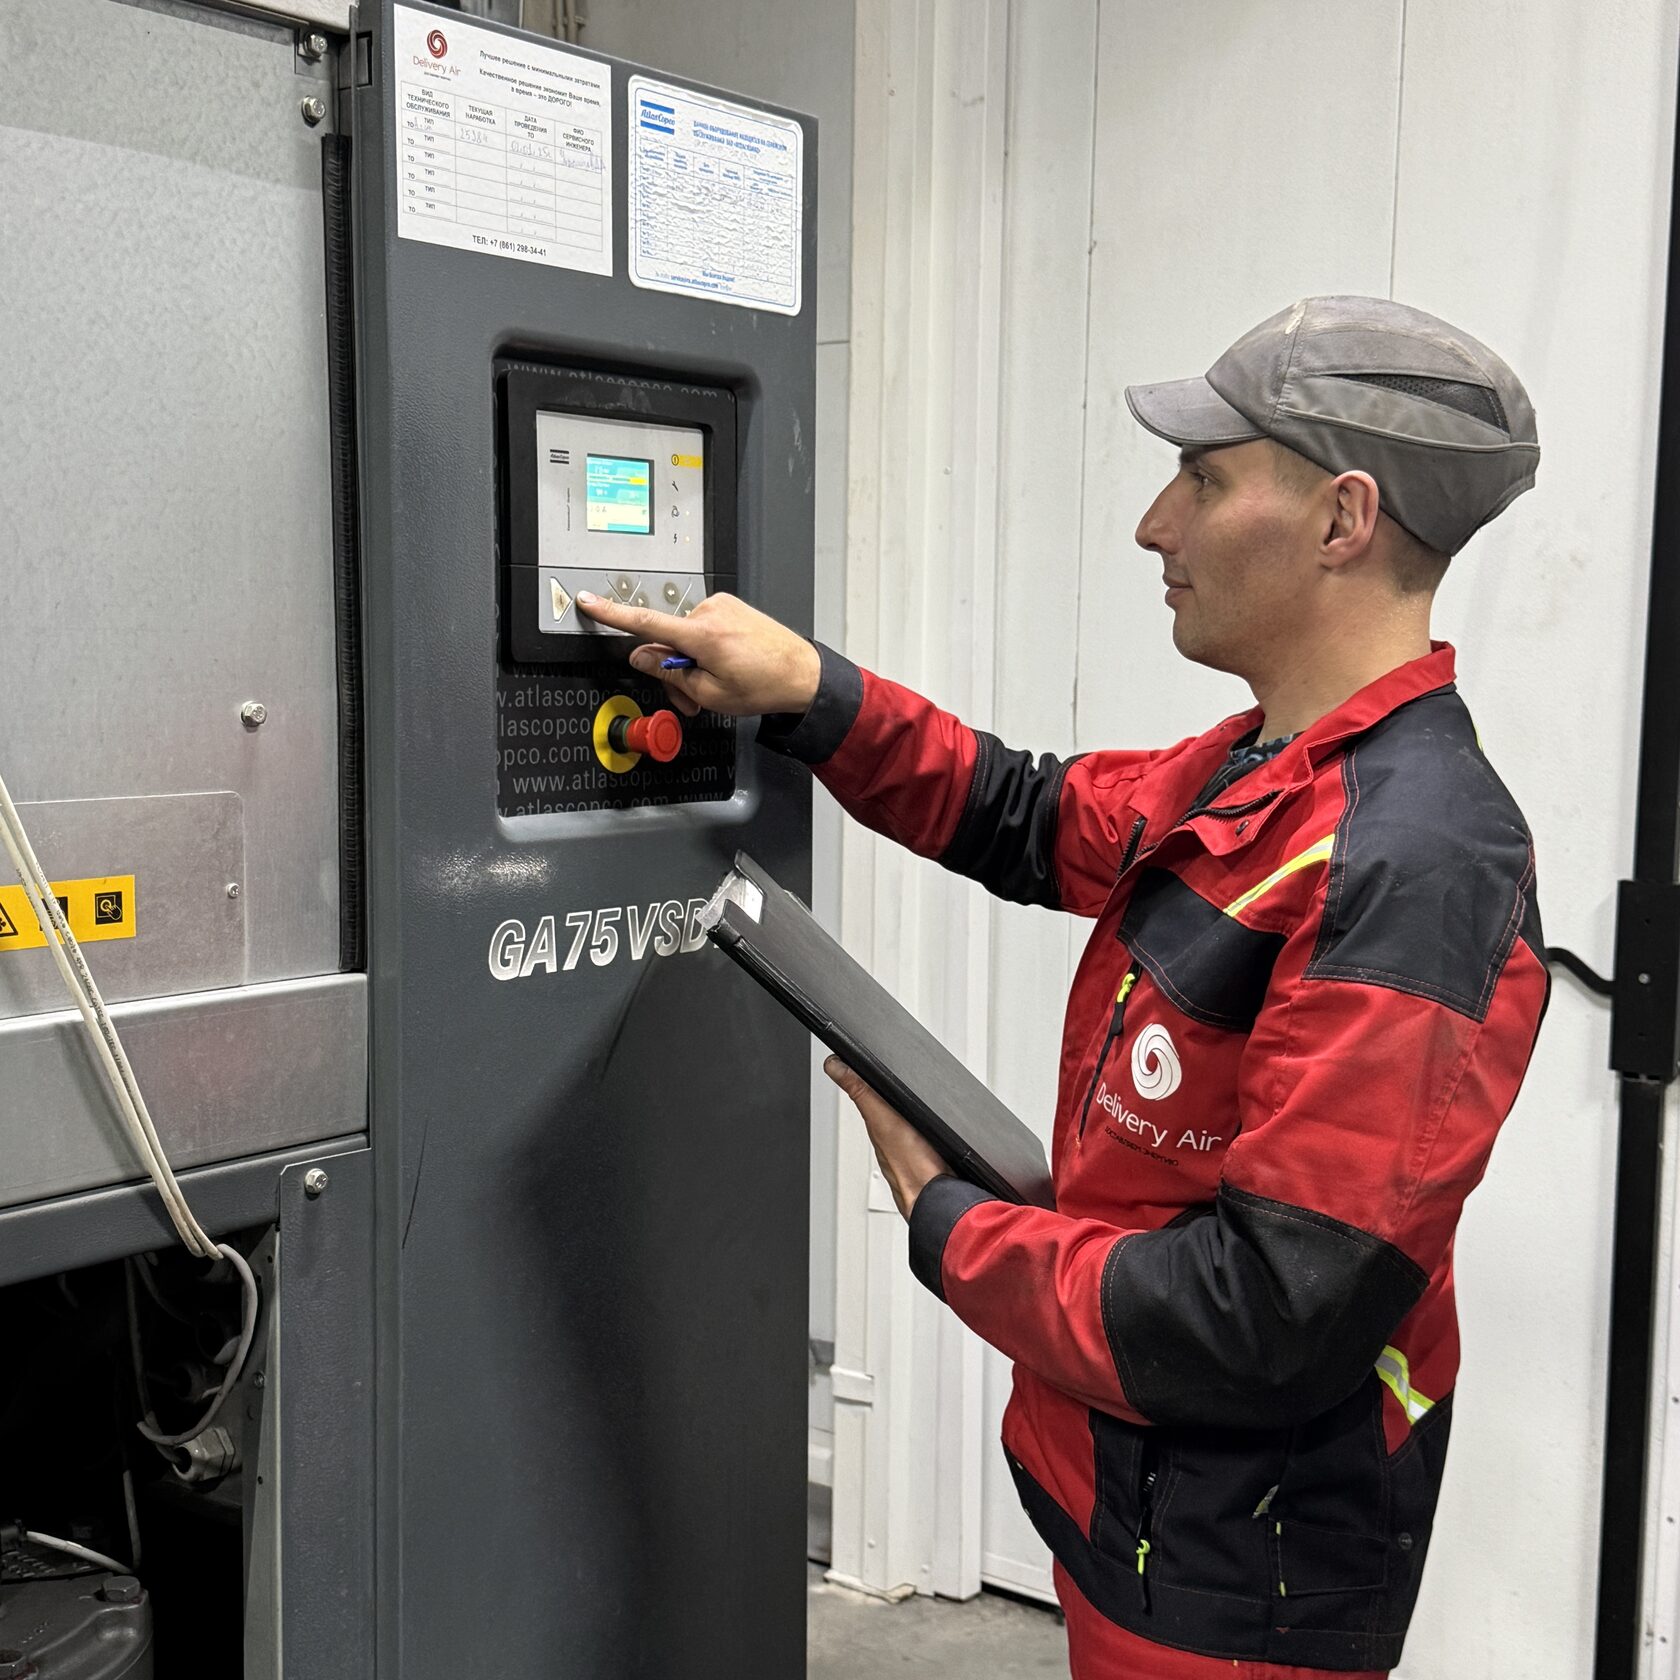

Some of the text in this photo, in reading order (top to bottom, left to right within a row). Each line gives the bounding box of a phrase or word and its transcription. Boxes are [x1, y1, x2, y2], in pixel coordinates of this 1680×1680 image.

[412, 55, 447, 75] Delivery
[449, 65, 461, 76] Air
[407, 93, 450, 110] ТЕХНИЧЕСКОГО
[421, 89, 433, 98] ВИД
[406, 102, 451, 118] ОБСЛУЖИВАНИЯ
[468, 104, 493, 116] ТЕКУЩАЯ
[465, 112, 496, 125] НАРАБОТКА
[524, 115, 537, 124] ДАТА
[472, 235, 547, 256] ТЕЛ: +7 (861) 298-34-41
[1096, 1082, 1168, 1148] Delivery
[1176, 1129, 1222, 1151] Air
